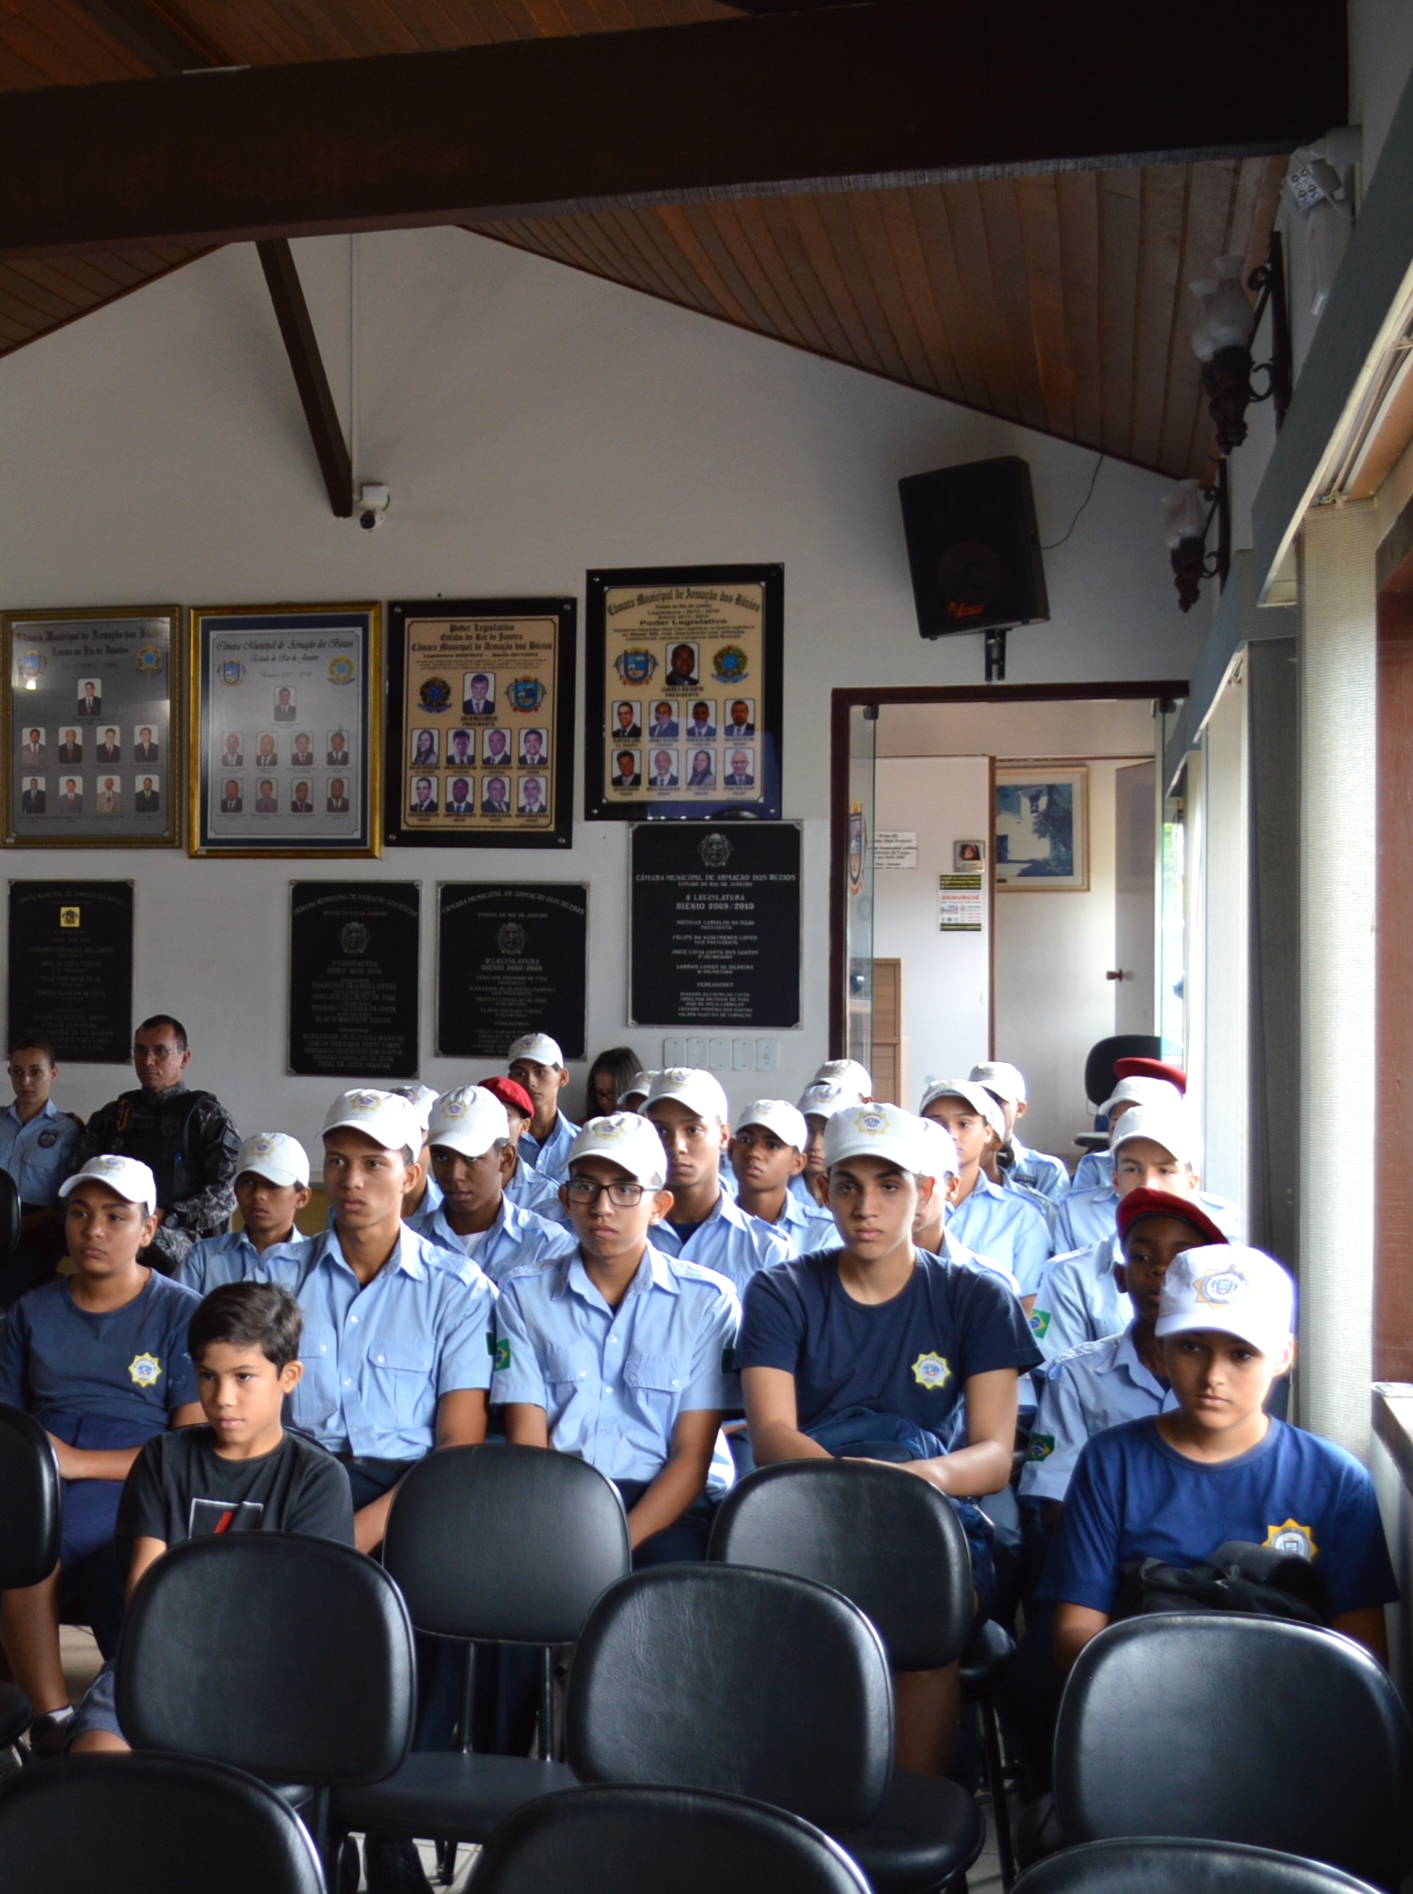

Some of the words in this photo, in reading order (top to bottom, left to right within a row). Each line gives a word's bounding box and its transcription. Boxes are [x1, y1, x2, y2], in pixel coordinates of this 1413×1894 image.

[608, 599, 635, 616] Câmara
[638, 589, 673, 605] Municipal
[676, 589, 684, 599] de
[686, 588, 718, 603] Armação
[720, 591, 734, 603] dos
[736, 594, 761, 612] Búzios
[672, 618, 727, 626] Legislativo
[450, 624, 471, 632] Poder
[474, 624, 514, 632] Legislativo
[499, 633, 523, 641] Janeiro
[412, 642, 437, 651] Câmara
[440, 642, 472, 651] Municipal
[474, 642, 482, 650] de
[484, 641, 513, 652] Armação
[515, 642, 526, 650] dos
[529, 641, 552, 650] Búzios
[468, 890, 503, 902] MUNICIPAL
